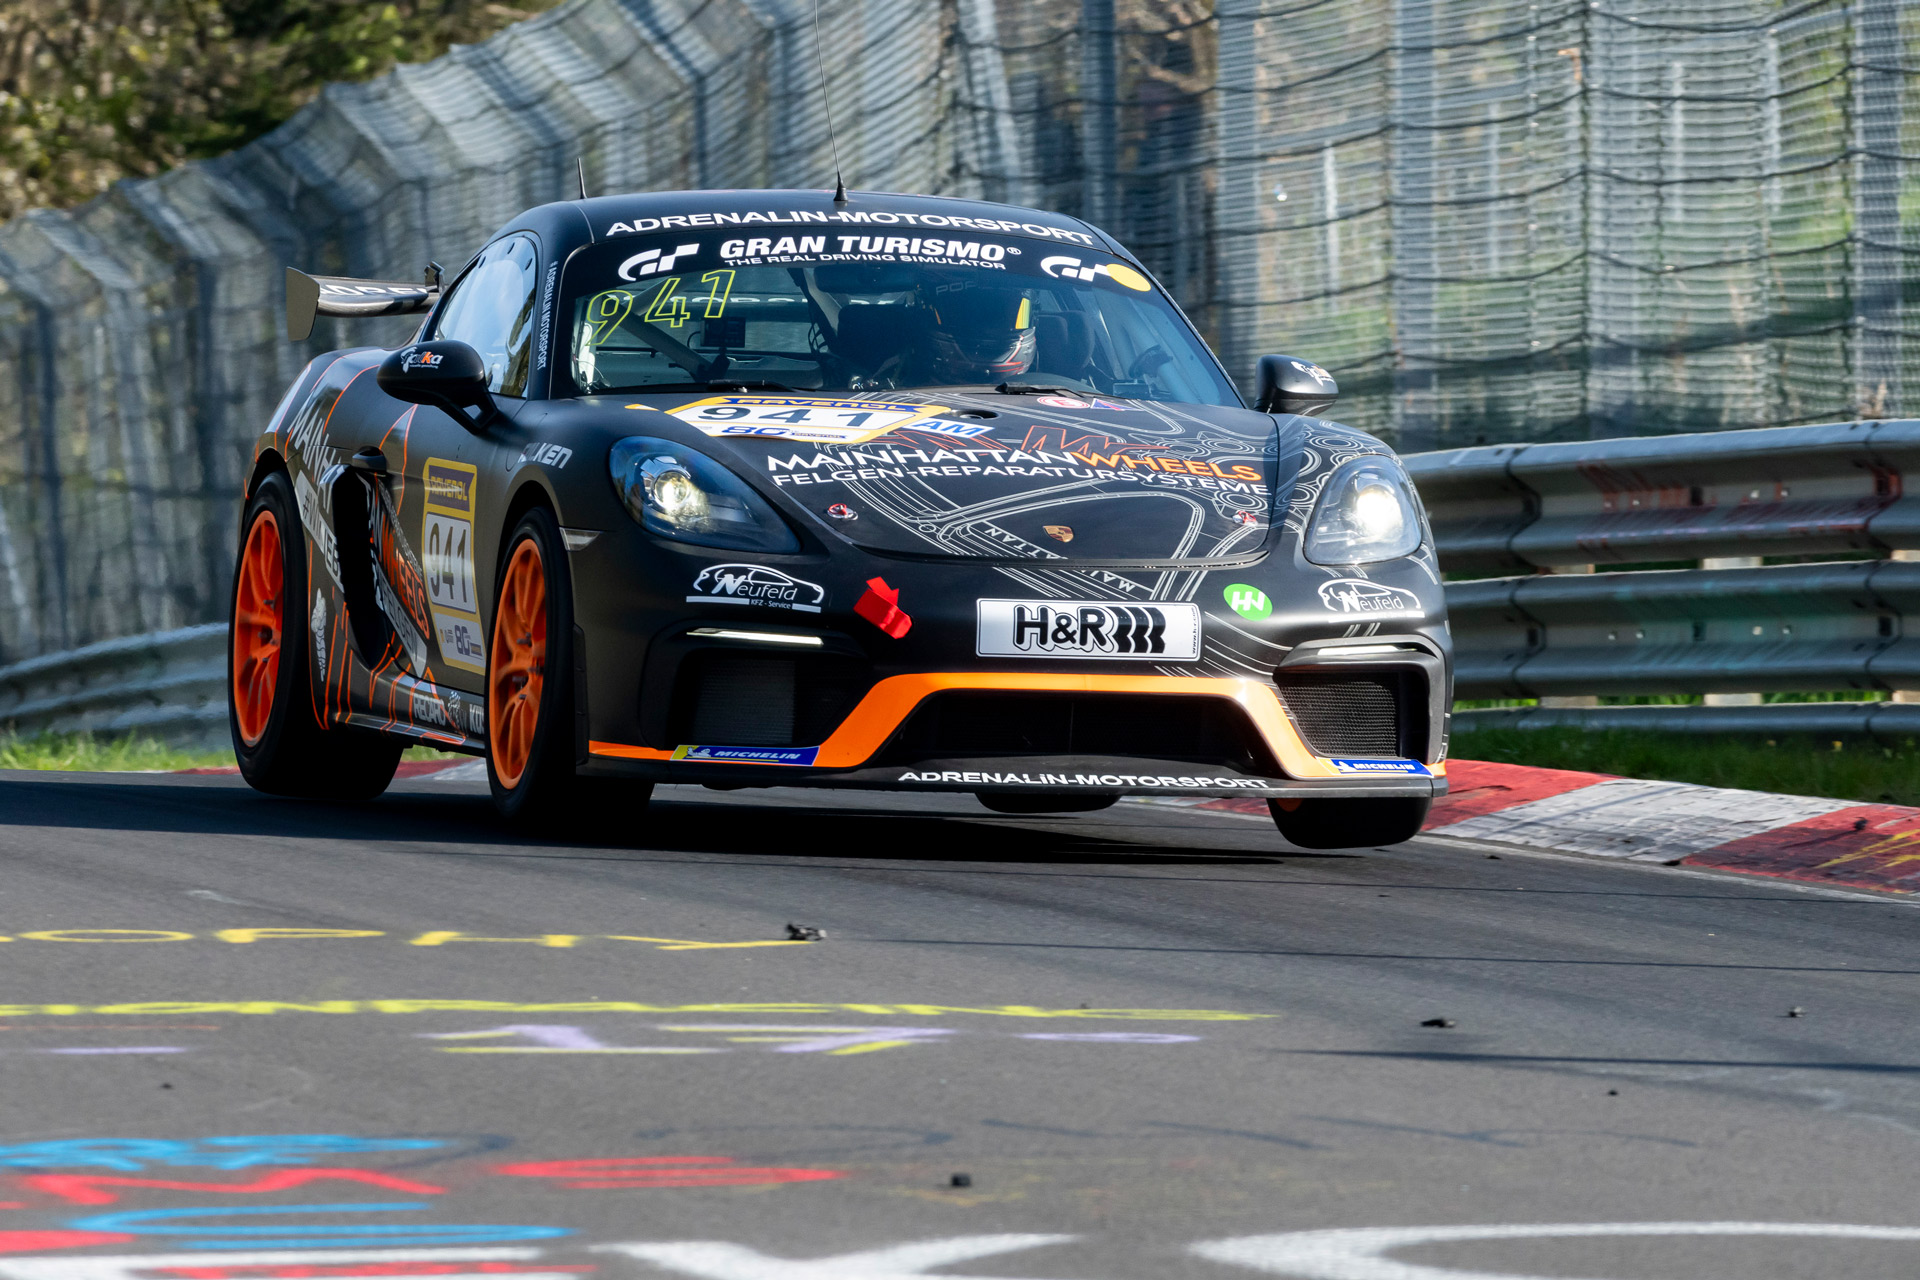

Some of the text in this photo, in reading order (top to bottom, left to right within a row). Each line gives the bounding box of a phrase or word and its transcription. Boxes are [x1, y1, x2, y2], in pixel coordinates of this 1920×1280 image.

[605, 211, 1093, 245] ADRENALIN-MOTORSPORT
[720, 236, 826, 259] GRAN
[724, 253, 1006, 270] THE REAL DRIVING SIMULATOR
[584, 269, 736, 347] 941
[698, 407, 874, 427] 941
[736, 399, 907, 412] RAVENOL
[913, 419, 983, 436] AM
[772, 465, 1272, 496] FELGEN-REPARATURSYSTEME
[429, 522, 467, 603] 941
[711, 573, 798, 601] Neufeld
[768, 600, 791, 610] Service
[1338, 590, 1405, 613] Neufeld
[1013, 604, 1115, 653] H&R
[714, 750, 801, 760] MICHELIN
[1352, 762, 1416, 771] MICHELIN
